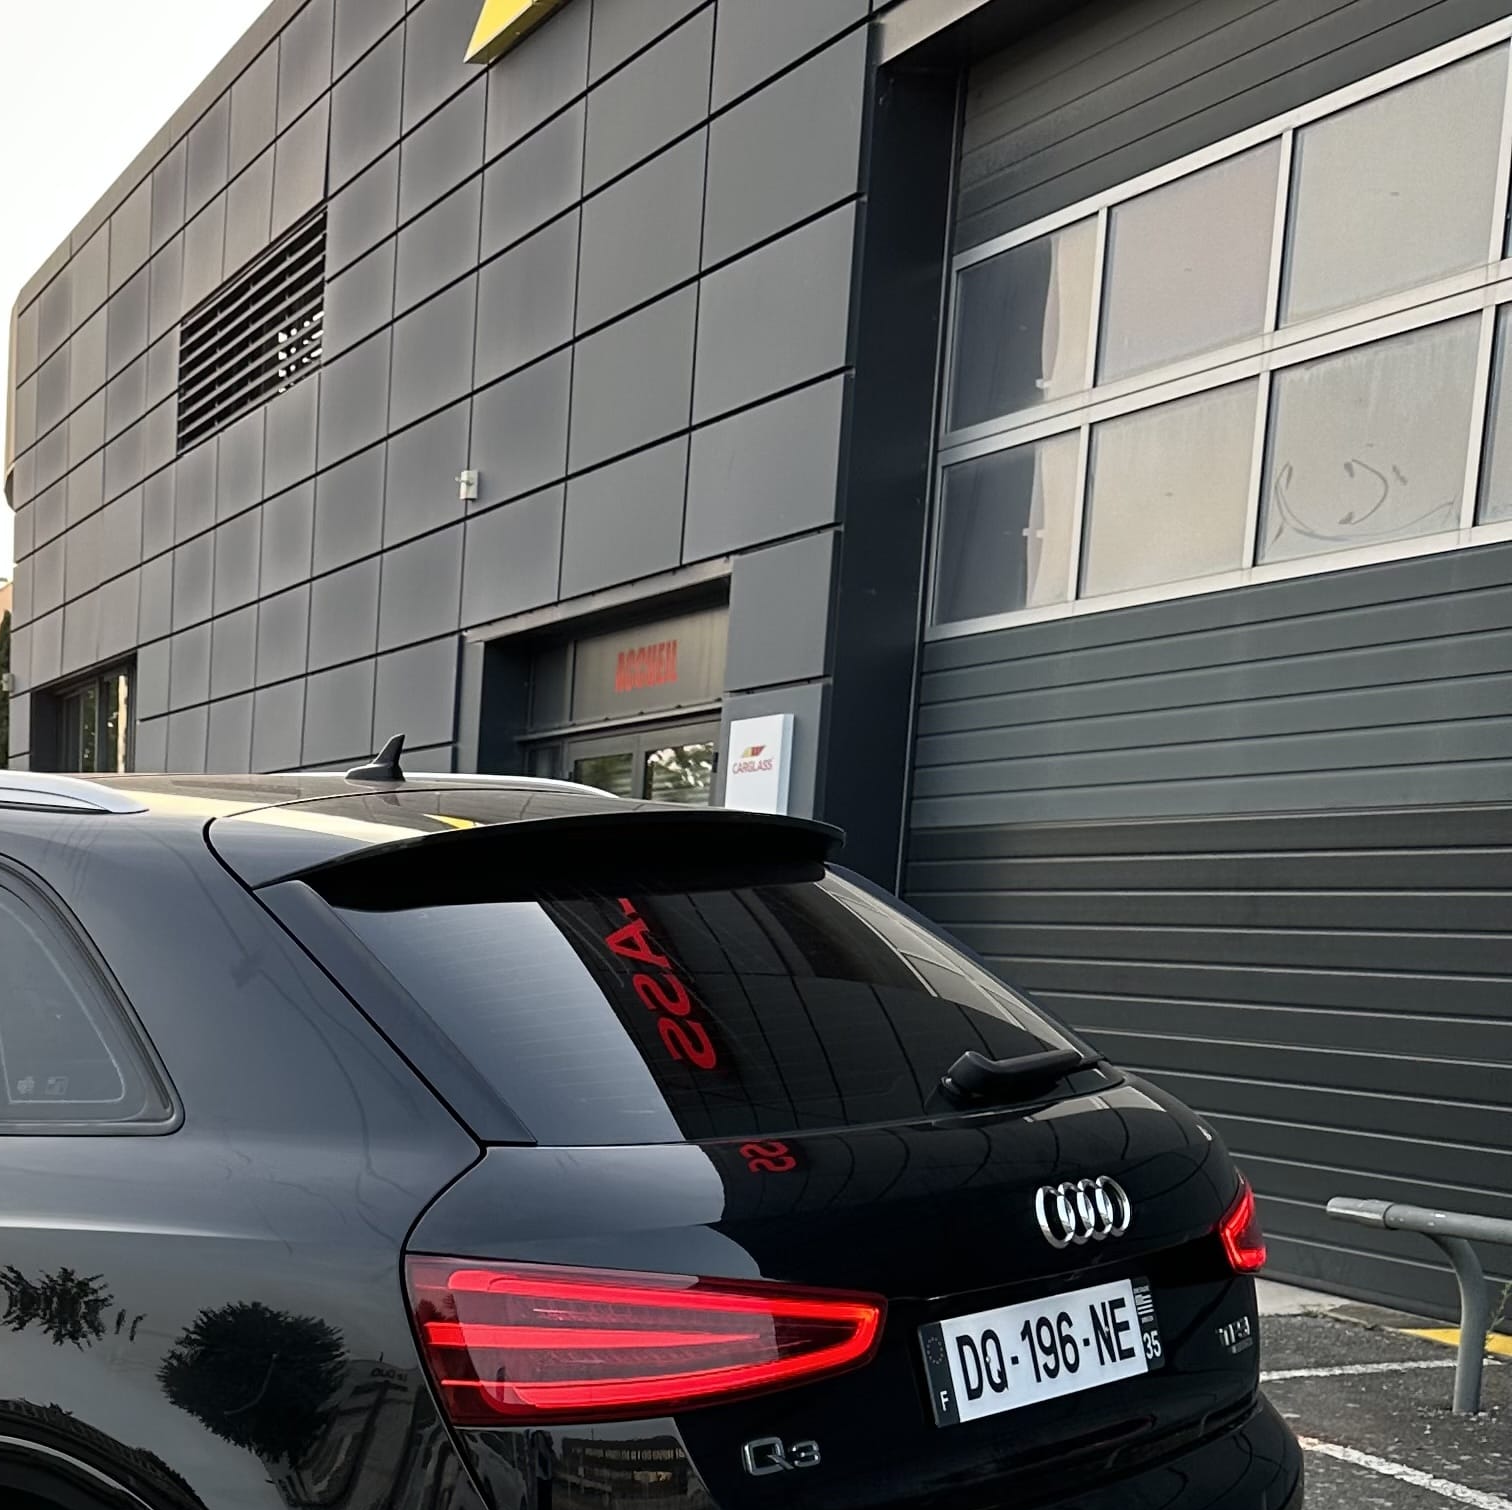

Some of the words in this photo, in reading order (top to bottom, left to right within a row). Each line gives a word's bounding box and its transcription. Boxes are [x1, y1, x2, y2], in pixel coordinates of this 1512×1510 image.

[615, 639, 678, 693] ACCUEIL
[732, 758, 773, 774] CARGLASS
[939, 1390, 950, 1412] F
[955, 1297, 1137, 1401] DQ-196-NE
[1142, 1330, 1163, 1360] 35
[741, 1436, 821, 1476] Q3
